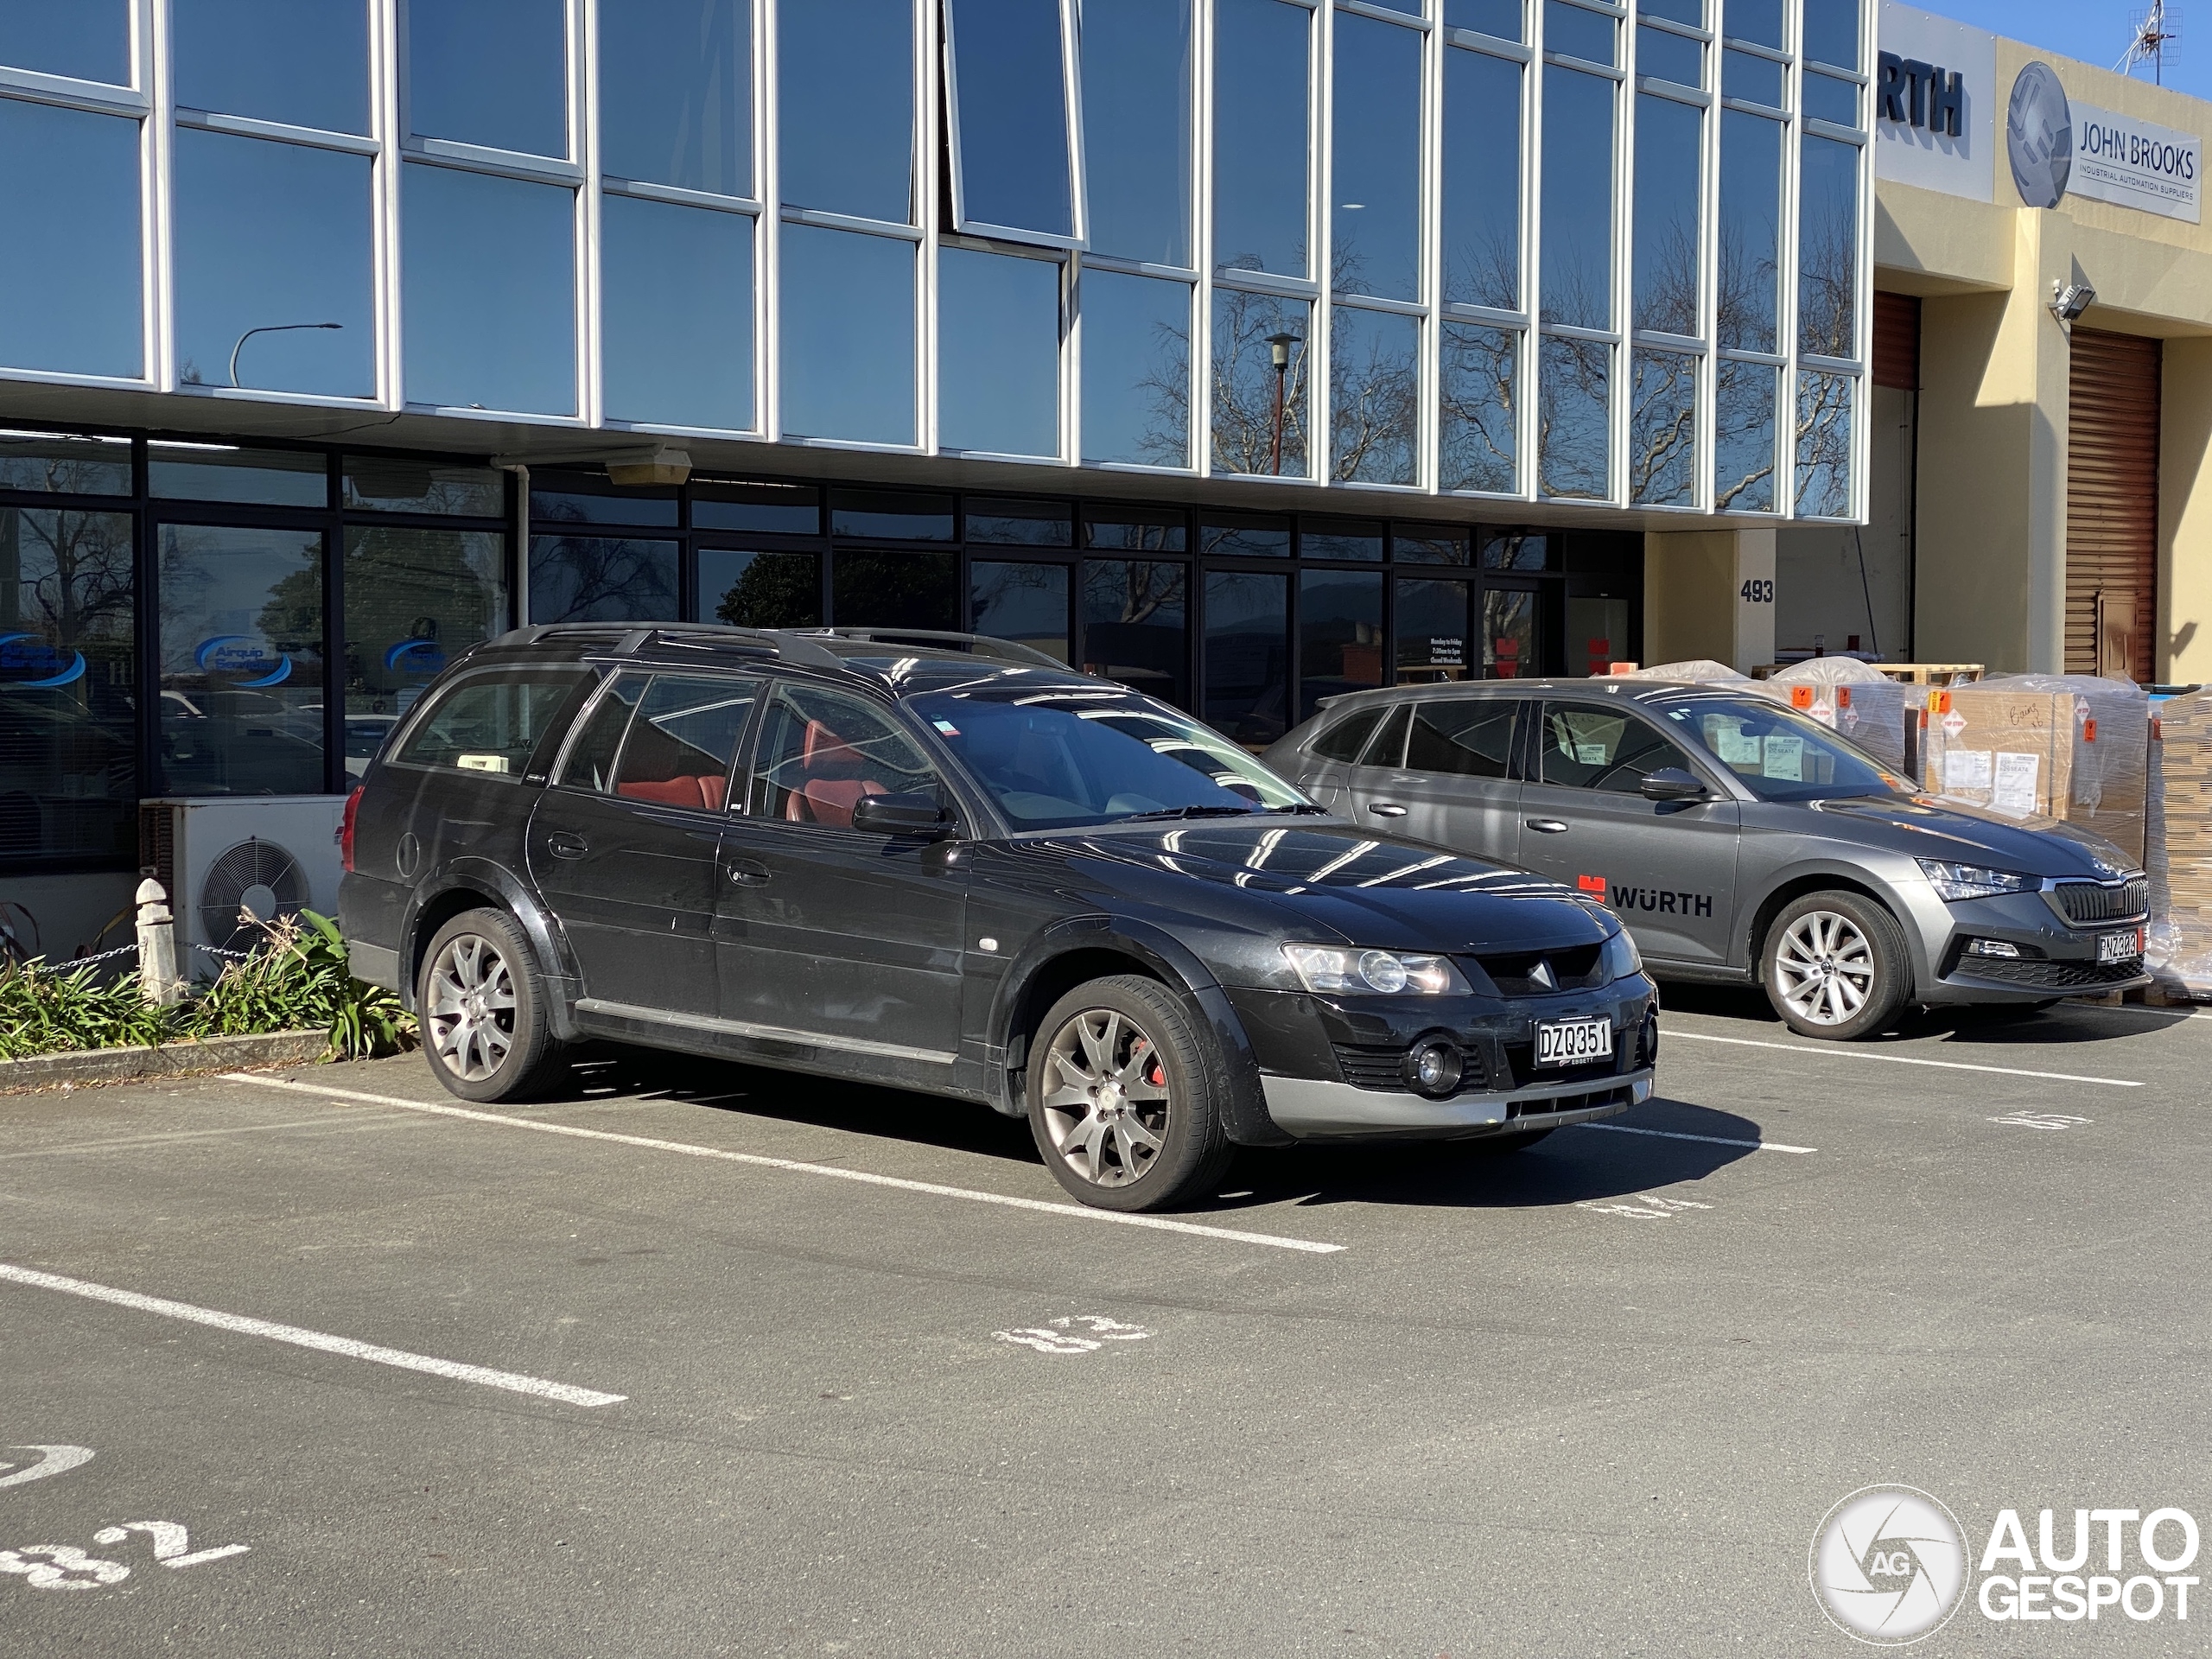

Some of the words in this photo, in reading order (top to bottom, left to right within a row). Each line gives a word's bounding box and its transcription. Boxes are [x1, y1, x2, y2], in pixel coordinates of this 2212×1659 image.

[2081, 121, 2126, 162] JOHN
[2131, 135, 2193, 180] BROOKS
[2079, 163, 2118, 181] INDUSTRIAL
[2119, 175, 2158, 191] AUTOMATION
[2160, 185, 2193, 200] SUPPLIERS
[1740, 580, 1773, 602] 493
[214, 658, 275, 670] Services
[215, 646, 264, 659] Airquip
[1540, 1023, 1607, 1058] DZQ351
